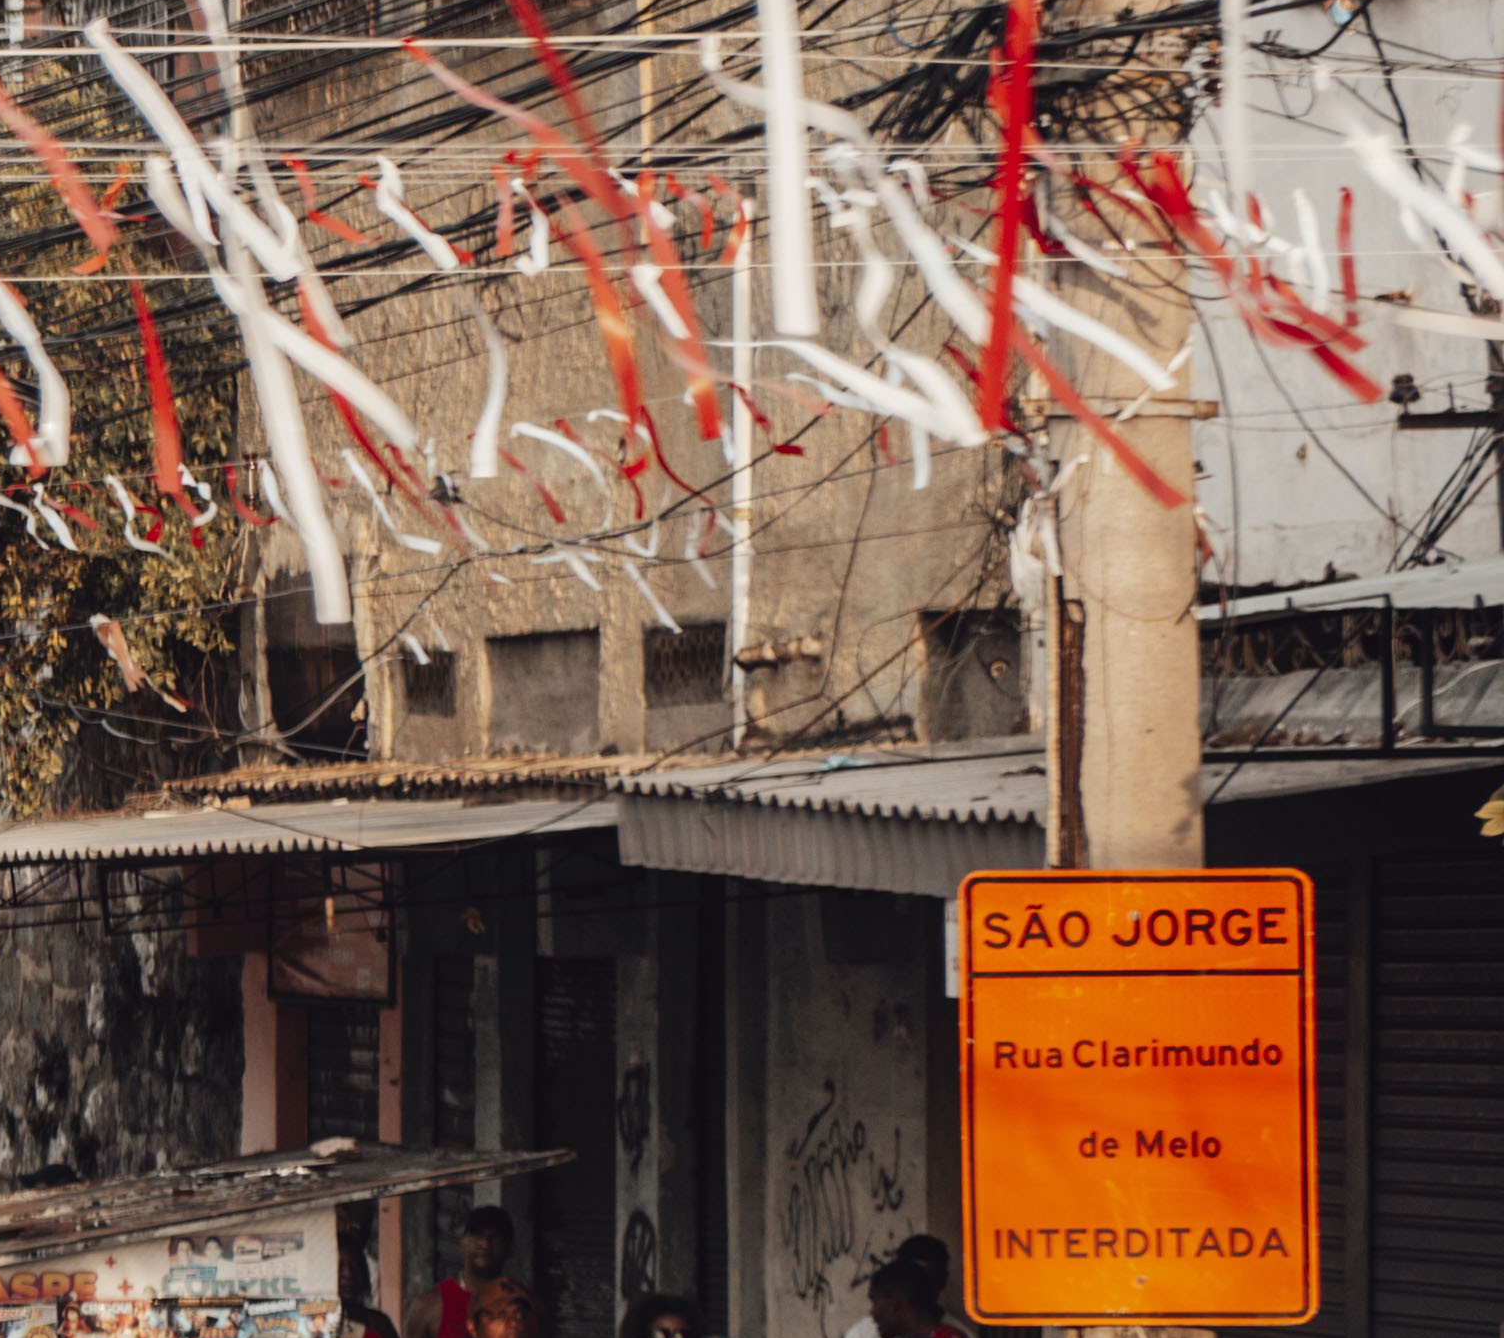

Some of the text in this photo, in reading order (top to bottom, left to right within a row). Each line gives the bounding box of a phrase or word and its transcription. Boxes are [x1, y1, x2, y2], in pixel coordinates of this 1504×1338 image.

[983, 904, 1288, 949] SÃO JORGE
[994, 1037, 1283, 1069] Rua Clarimundo
[1078, 1129, 1222, 1159] de Melo
[994, 1227, 1290, 1259] INTERDITADA
